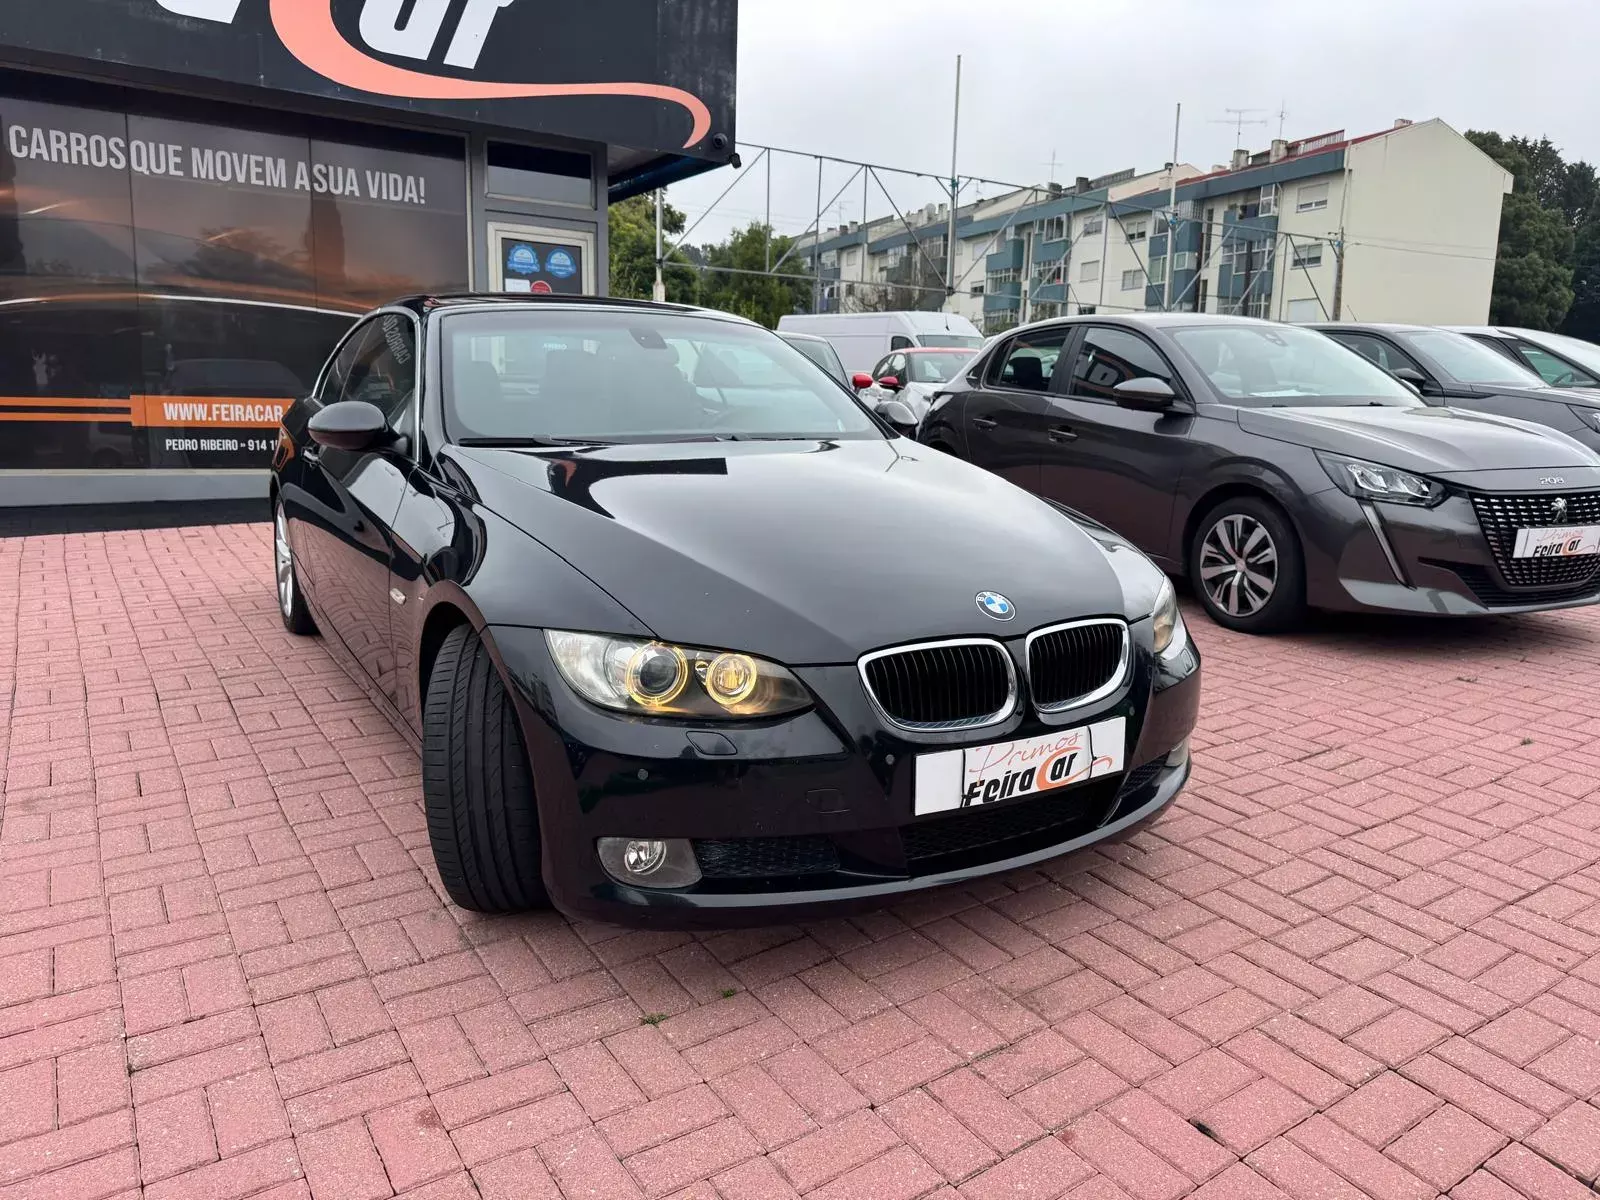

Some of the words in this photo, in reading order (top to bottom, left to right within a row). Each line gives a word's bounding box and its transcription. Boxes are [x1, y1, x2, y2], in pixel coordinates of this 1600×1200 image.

[8, 125, 127, 170] CARROS
[129, 139, 184, 177] QUE
[191, 147, 287, 189] MOVEM
[294, 160, 311, 192] A
[312, 163, 360, 198] SUA
[365, 169, 426, 205] VIDA!
[163, 402, 291, 422] WWW.FEIRACAR
[165, 438, 198, 451] PEDRO
[200, 439, 239, 451] RIBEIRO
[247, 439, 267, 451] 914
